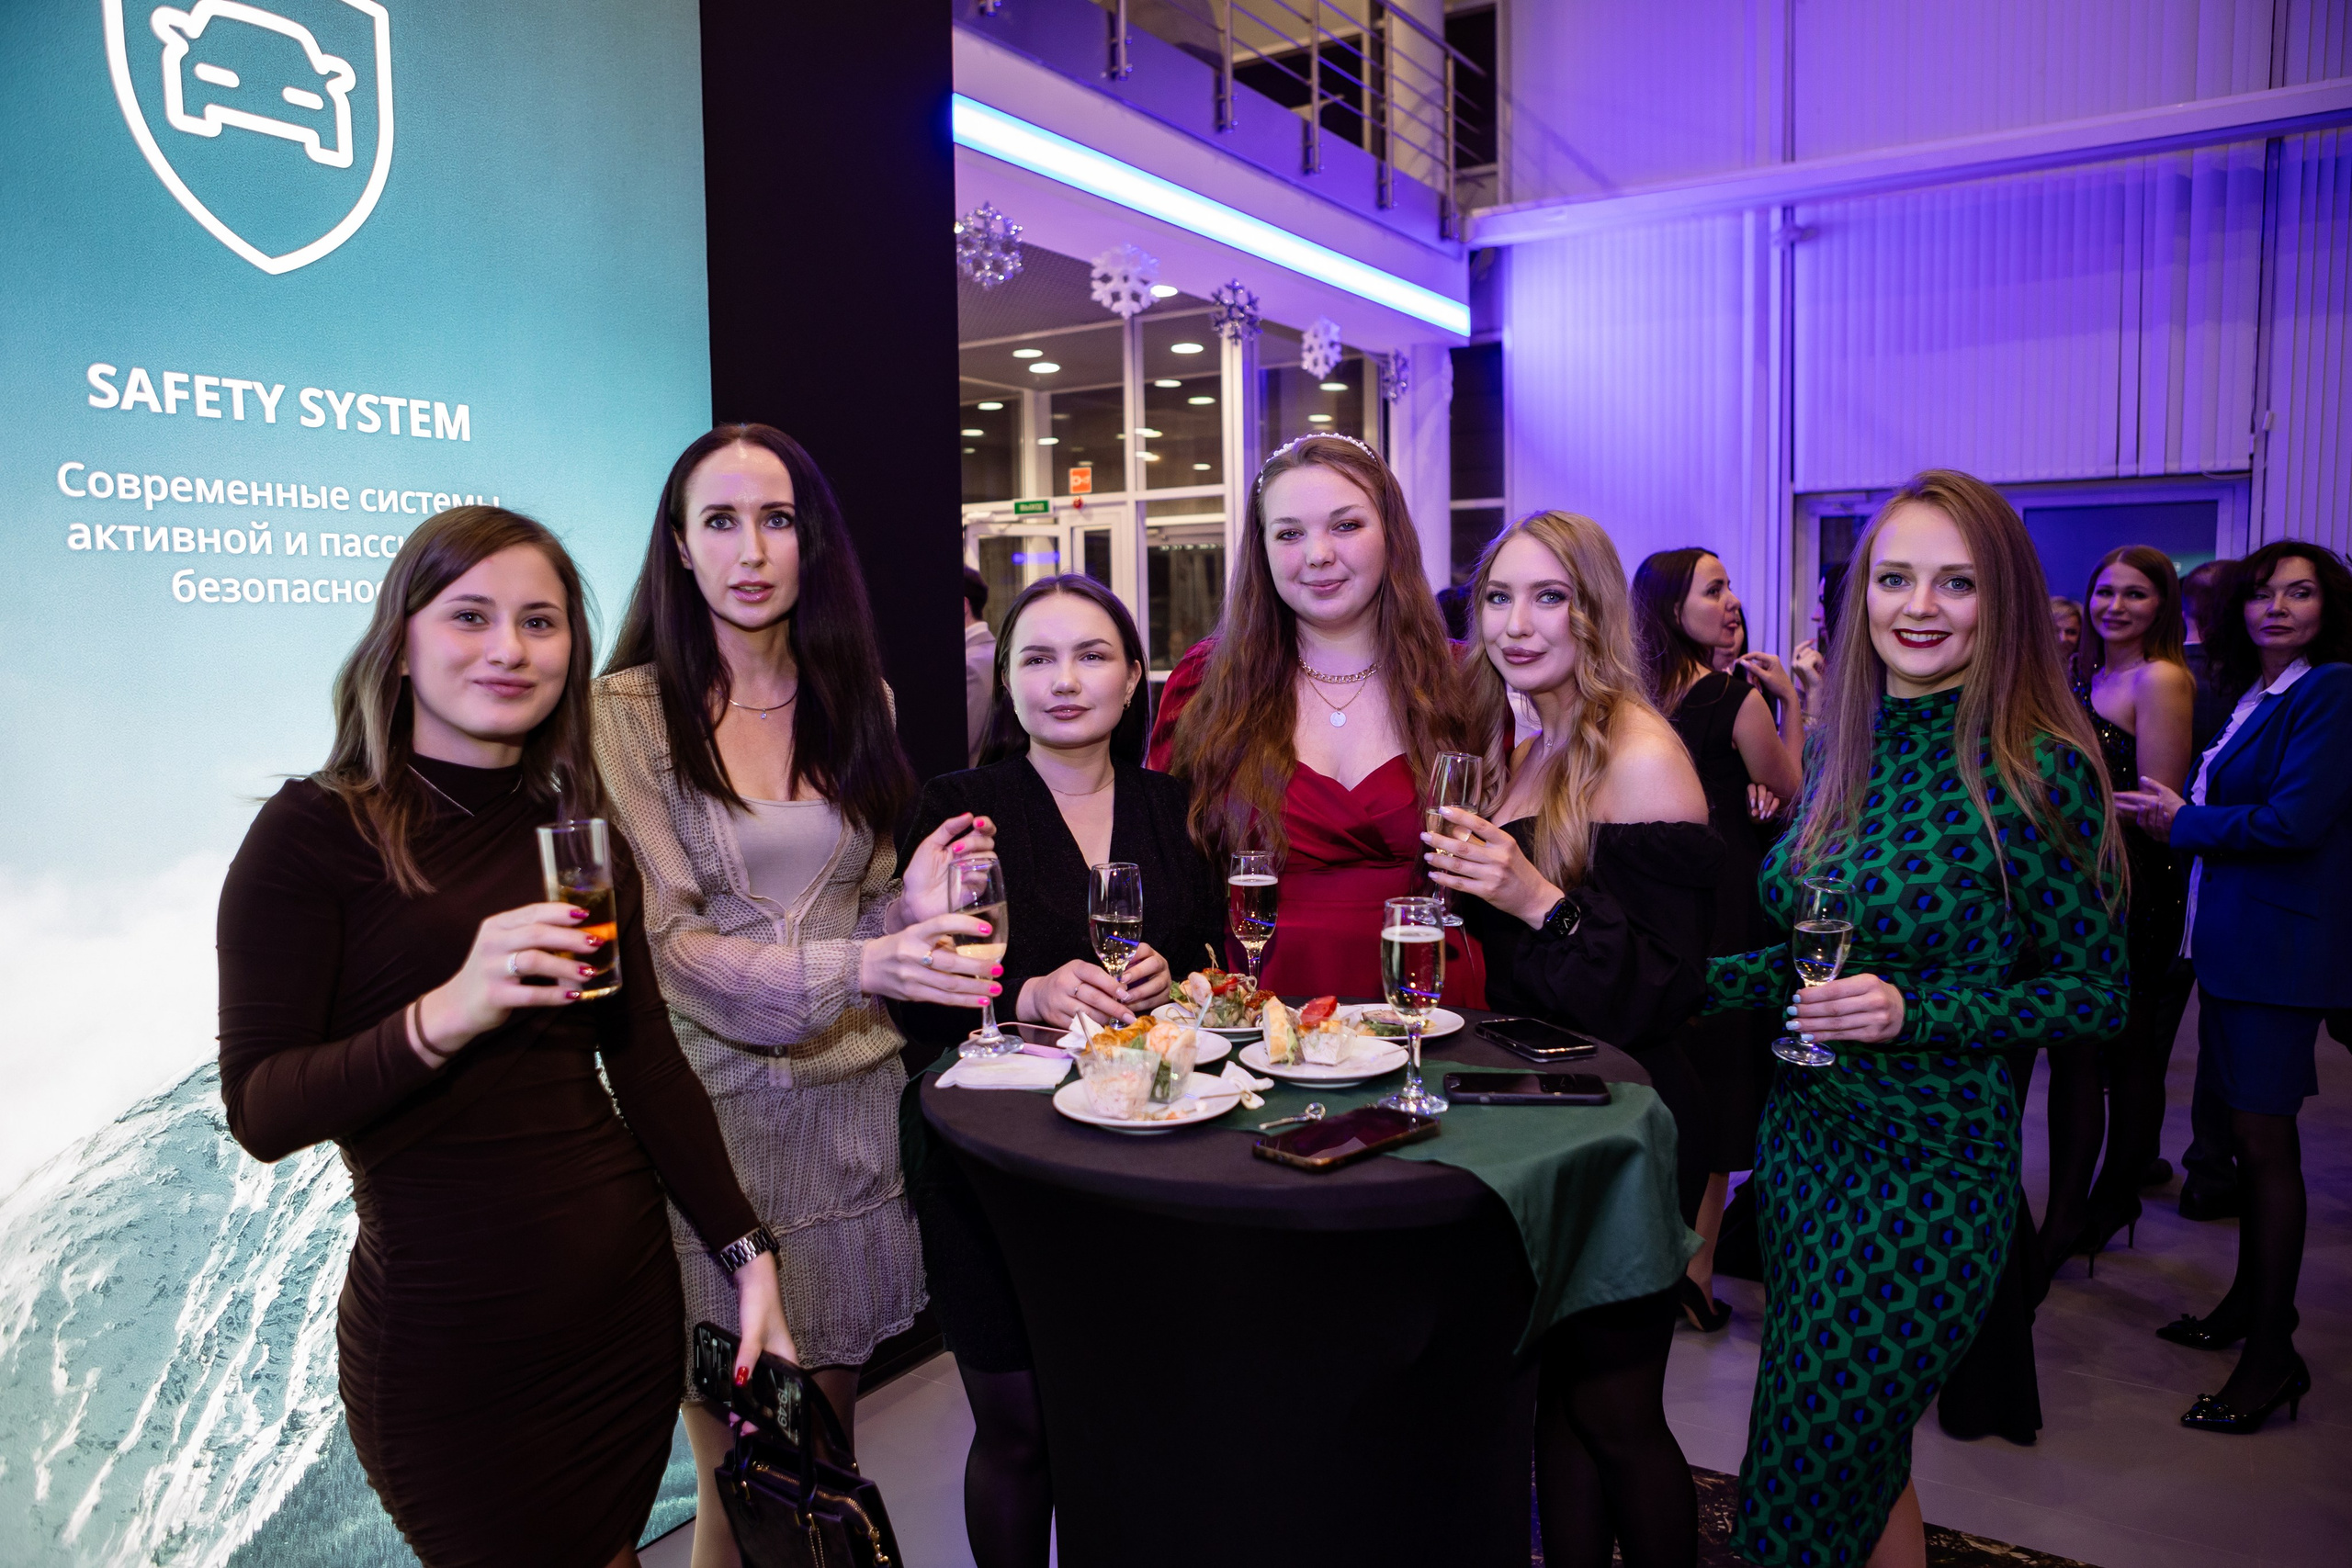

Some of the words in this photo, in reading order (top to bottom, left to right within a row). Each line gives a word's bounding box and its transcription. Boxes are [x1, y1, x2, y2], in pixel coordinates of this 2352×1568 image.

[87, 363, 286, 423] SAFETY
[300, 388, 471, 441] SYSTEM
[57, 461, 350, 511] Современные
[67, 520, 273, 555] активной
[284, 530, 310, 557] и
[172, 568, 383, 604] безопасно
